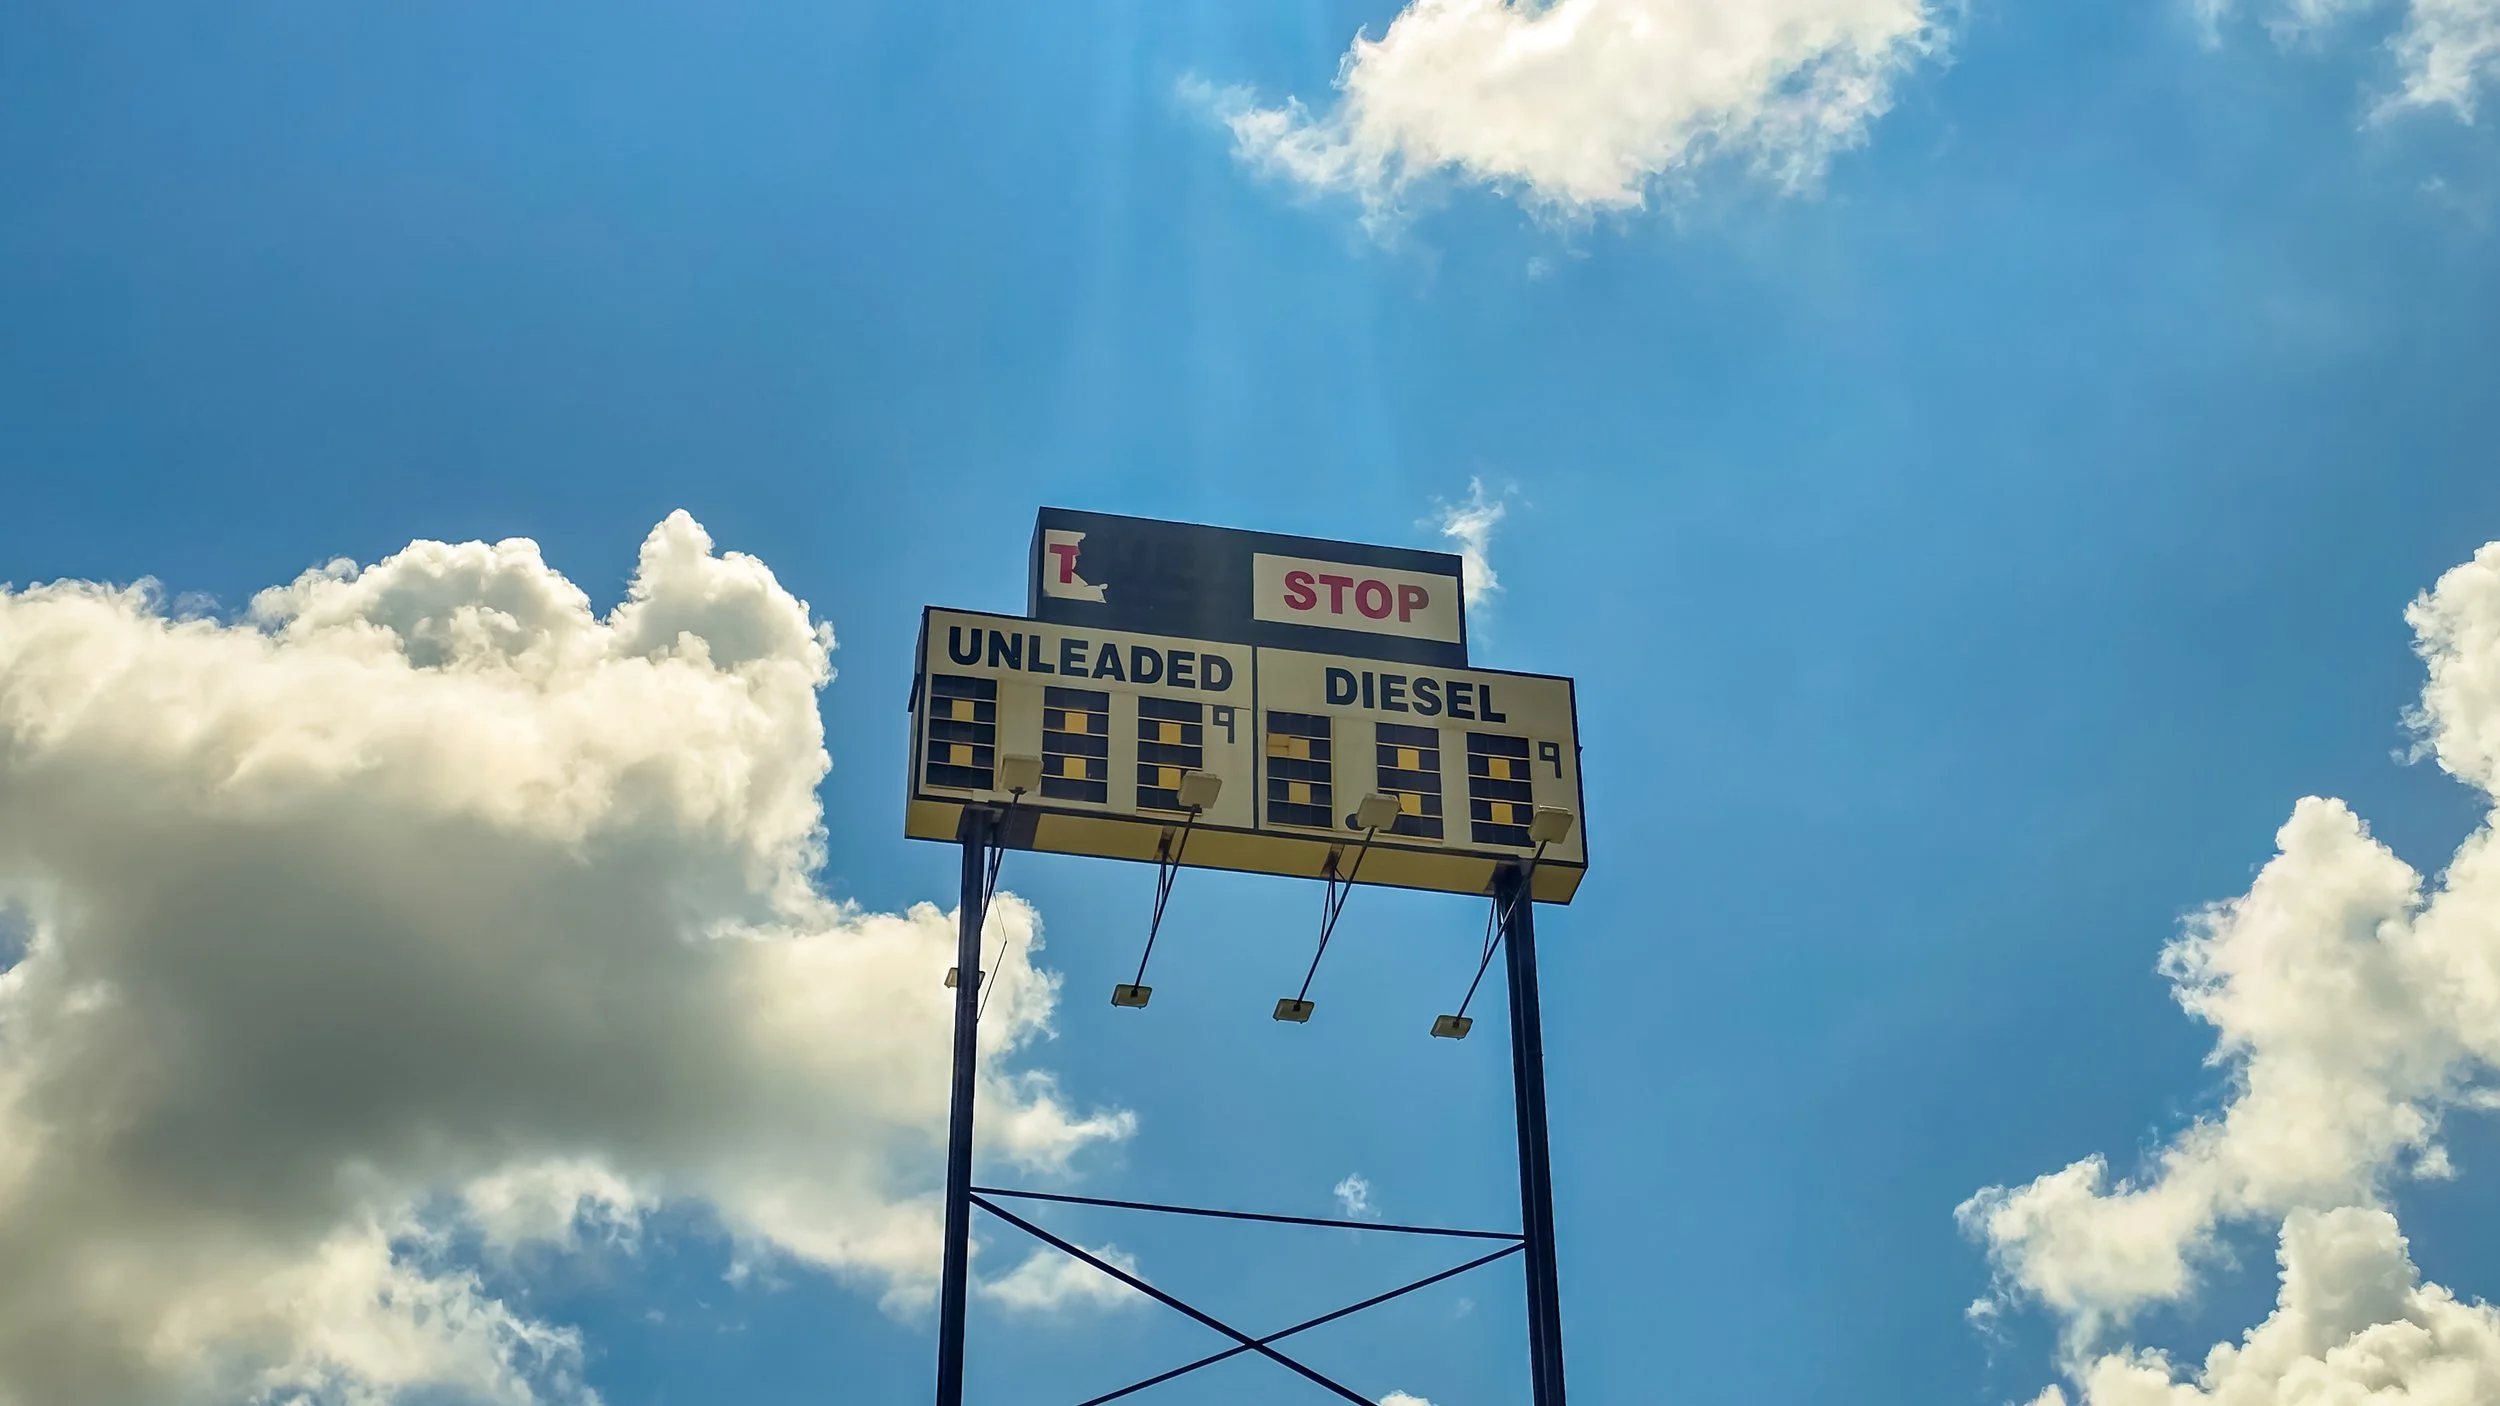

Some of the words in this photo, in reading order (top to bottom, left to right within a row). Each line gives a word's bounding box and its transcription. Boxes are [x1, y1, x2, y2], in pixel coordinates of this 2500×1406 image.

[1283, 570, 1430, 623] STOP
[948, 626, 1234, 692] UNLEADED
[1325, 666, 1507, 724] DIESEL
[1212, 705, 1235, 744] 9
[1537, 740, 1562, 779] 9
